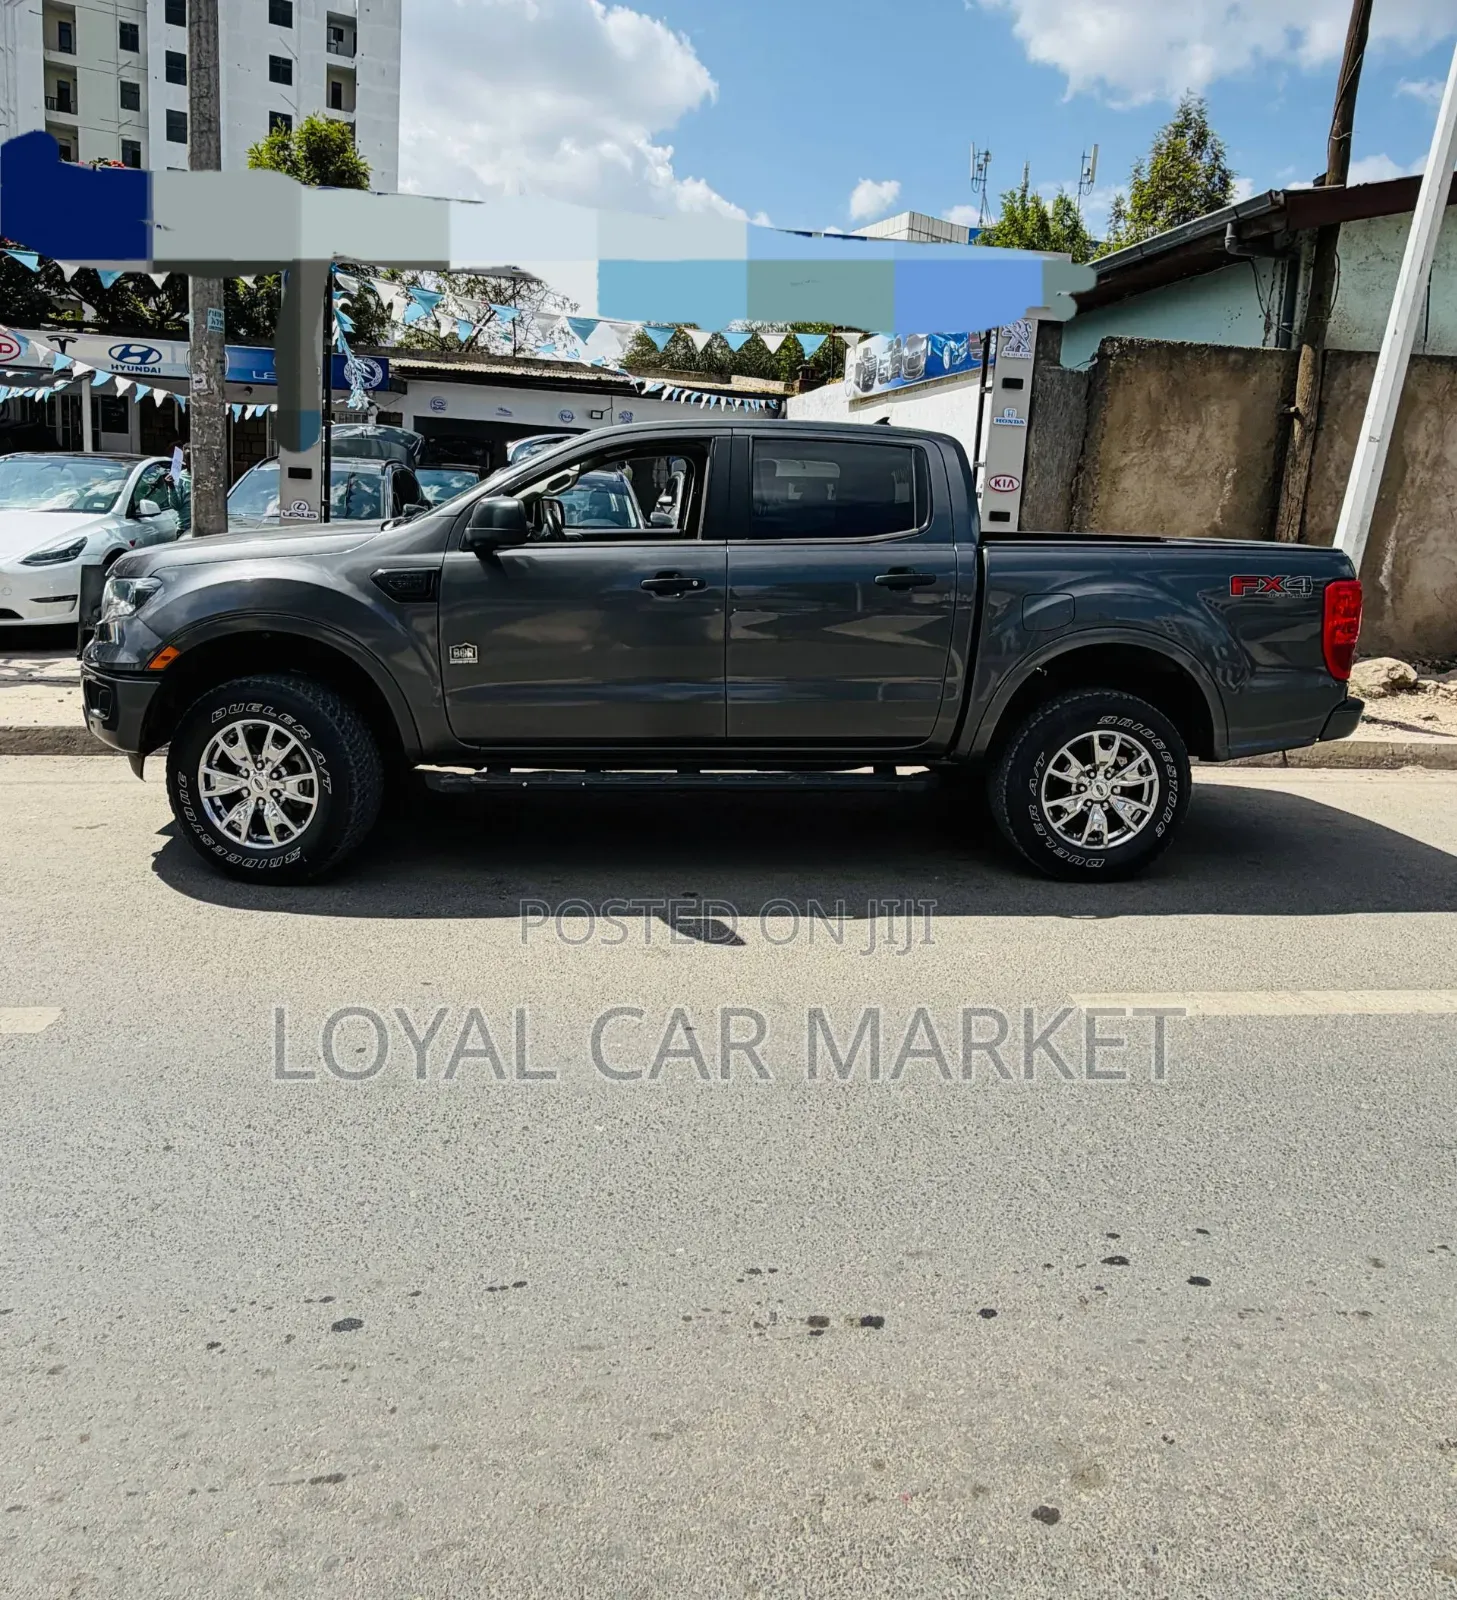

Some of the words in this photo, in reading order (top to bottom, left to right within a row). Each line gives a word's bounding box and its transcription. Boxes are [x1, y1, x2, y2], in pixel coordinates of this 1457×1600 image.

[111, 363, 161, 374] HYUNDAI
[994, 478, 1015, 489] KIA
[282, 510, 317, 519] LEXUS
[1229, 574, 1313, 597] FX4
[211, 703, 311, 740] DUELER
[1097, 715, 1178, 838] BRIDGESTONE
[178, 770, 301, 868] BRIDGESTONE
[1029, 804, 1105, 868] DUELER
